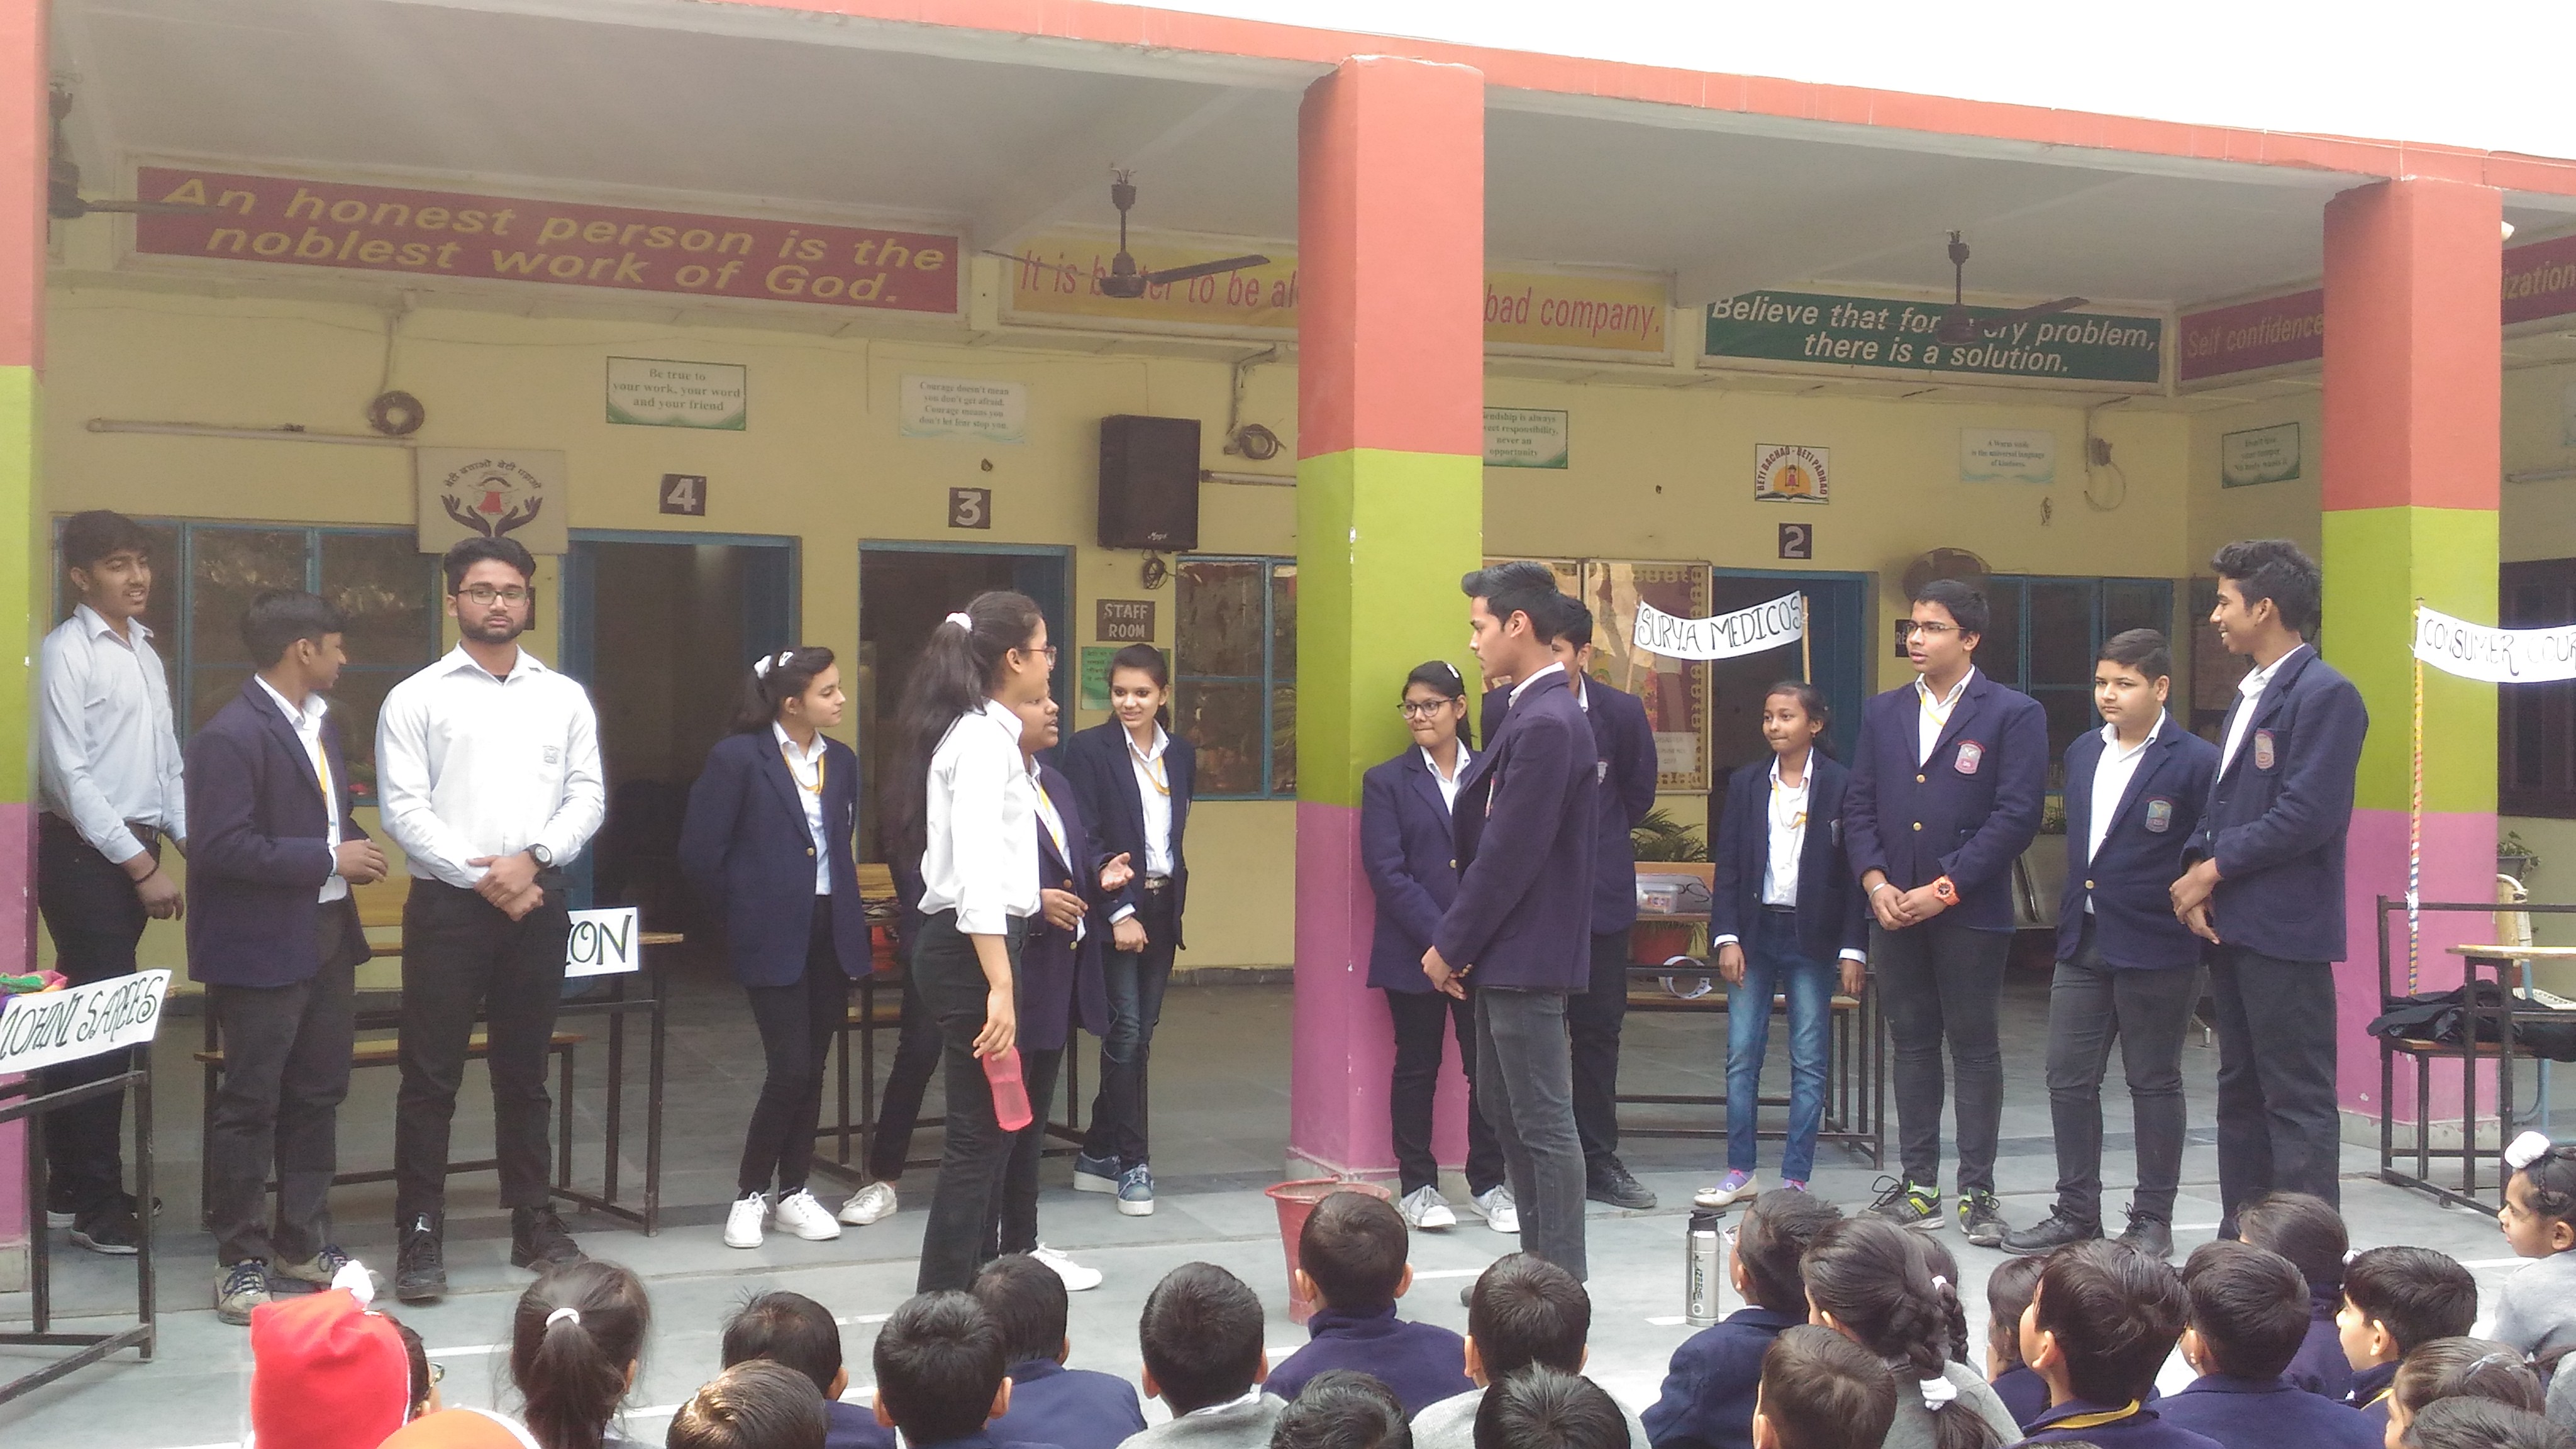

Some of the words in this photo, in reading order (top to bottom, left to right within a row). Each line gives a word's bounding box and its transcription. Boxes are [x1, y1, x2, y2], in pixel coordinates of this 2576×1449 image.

[160, 179, 258, 214] An
[283, 187, 516, 235] honest
[536, 216, 753, 255] person
[778, 230, 827, 261] is
[853, 238, 944, 270] the
[206, 226, 460, 269] noblest
[491, 249, 649, 285] work
[674, 260, 744, 289] of
[765, 264, 897, 303] God.
[1020, 250, 1043, 291] It
[1053, 251, 1078, 294] is
[1187, 272, 1216, 303] to
[1226, 269, 1260, 307] be
[1484, 283, 1532, 324] bad
[1540, 297, 1660, 341] company.
[1711, 296, 1819, 325] Believe
[1830, 303, 1889, 330] that
[1899, 306, 1941, 333] for
[2035, 319, 2155, 351] problem,
[2187, 326, 2222, 358] Self
[2226, 314, 2324, 352] confidence
[1804, 331, 1879, 360] there
[1889, 336, 1913, 363] is
[1923, 346, 1940, 364] a
[1950, 344, 2068, 372] solution.
[649, 369, 663, 378] Be
[667, 370, 691, 380] true
[694, 371, 706, 381] to
[613, 382, 640, 392] your
[644, 383, 678, 394] work,
[680, 387, 707, 396] your
[711, 388, 741, 398] word
[920, 381, 955, 392] Courage
[987, 387, 1009, 396] mean
[633, 397, 655, 408] and
[659, 401, 686, 410] your
[689, 400, 724, 411] friend
[925, 404, 959, 416] Courage
[989, 410, 1004, 419] you
[943, 417, 953, 426] let
[955, 418, 971, 427] fear
[973, 421, 990, 430] stop
[1528, 415, 1556, 423] always
[1489, 448, 1538, 457] opportunity
[1761, 445, 1790, 471] BACHAO
[1796, 446, 1814, 462] BETI
[1757, 470, 1767, 491] BETI
[667, 478, 696, 511] 4
[955, 491, 982, 526] 3
[1784, 526, 1804, 558] 2
[1104, 603, 1148, 619] STAFF
[1638, 608, 1702, 653] SURYA
[1710, 595, 1802, 650] MEDICOS
[1108, 623, 1145, 638] ROOM
[2424, 618, 2519, 677] CONSUMER
[76, 975, 164, 1043] SAREES
